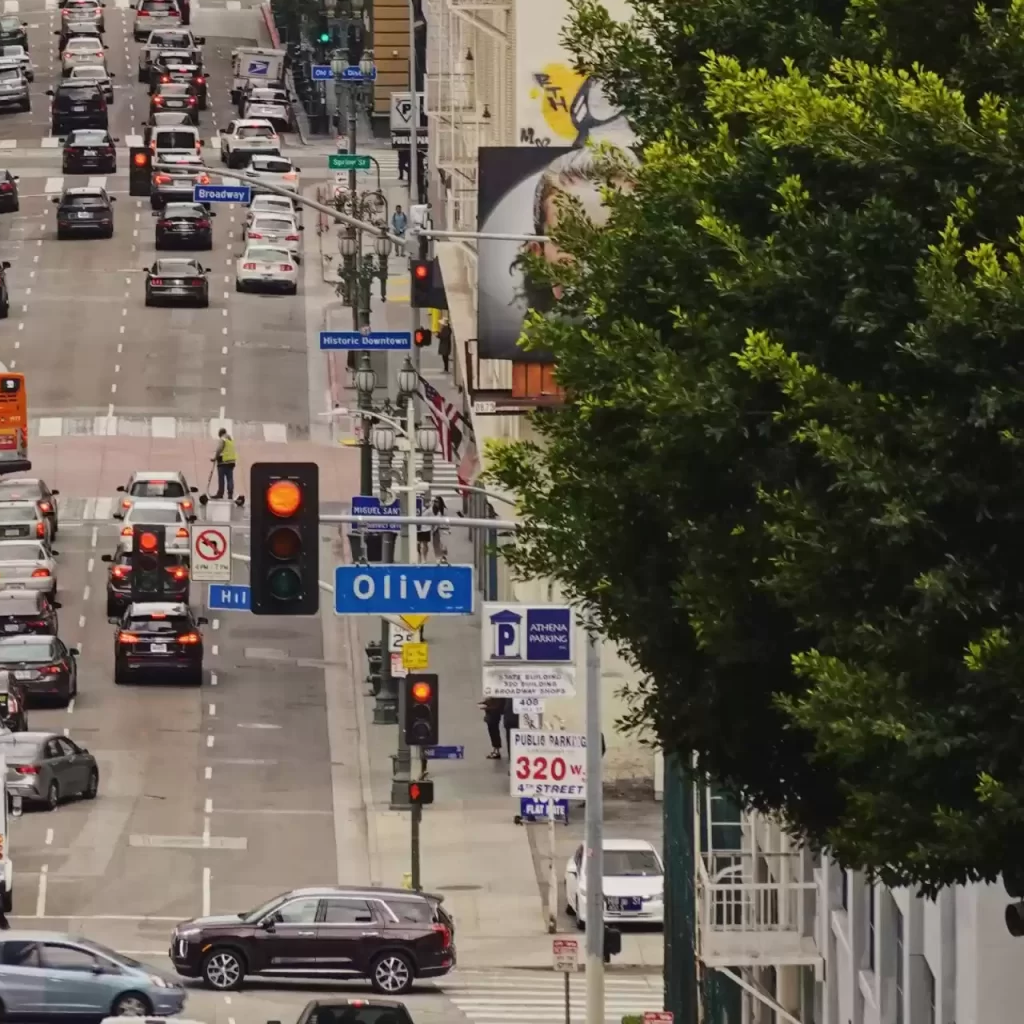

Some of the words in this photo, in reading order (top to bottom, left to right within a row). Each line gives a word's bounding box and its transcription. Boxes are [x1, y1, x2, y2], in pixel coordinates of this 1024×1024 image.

[402, 103, 411, 114] P
[333, 158, 357, 167] Spring
[358, 158, 366, 166] St
[198, 188, 245, 201] Broadway
[323, 337, 359, 345] Historic
[362, 337, 408, 345] Downtown
[353, 506, 381, 514] MIGUEL
[353, 574, 455, 599] Olive
[221, 589, 246, 604] Hil
[529, 623, 568, 632] ATHENA
[498, 623, 515, 656] P
[529, 635, 568, 643] PARKING
[515, 734, 545, 747] PUBLIC
[516, 756, 567, 781] 320
[536, 784, 584, 794] STREET
[526, 804, 544, 815] FLAT
